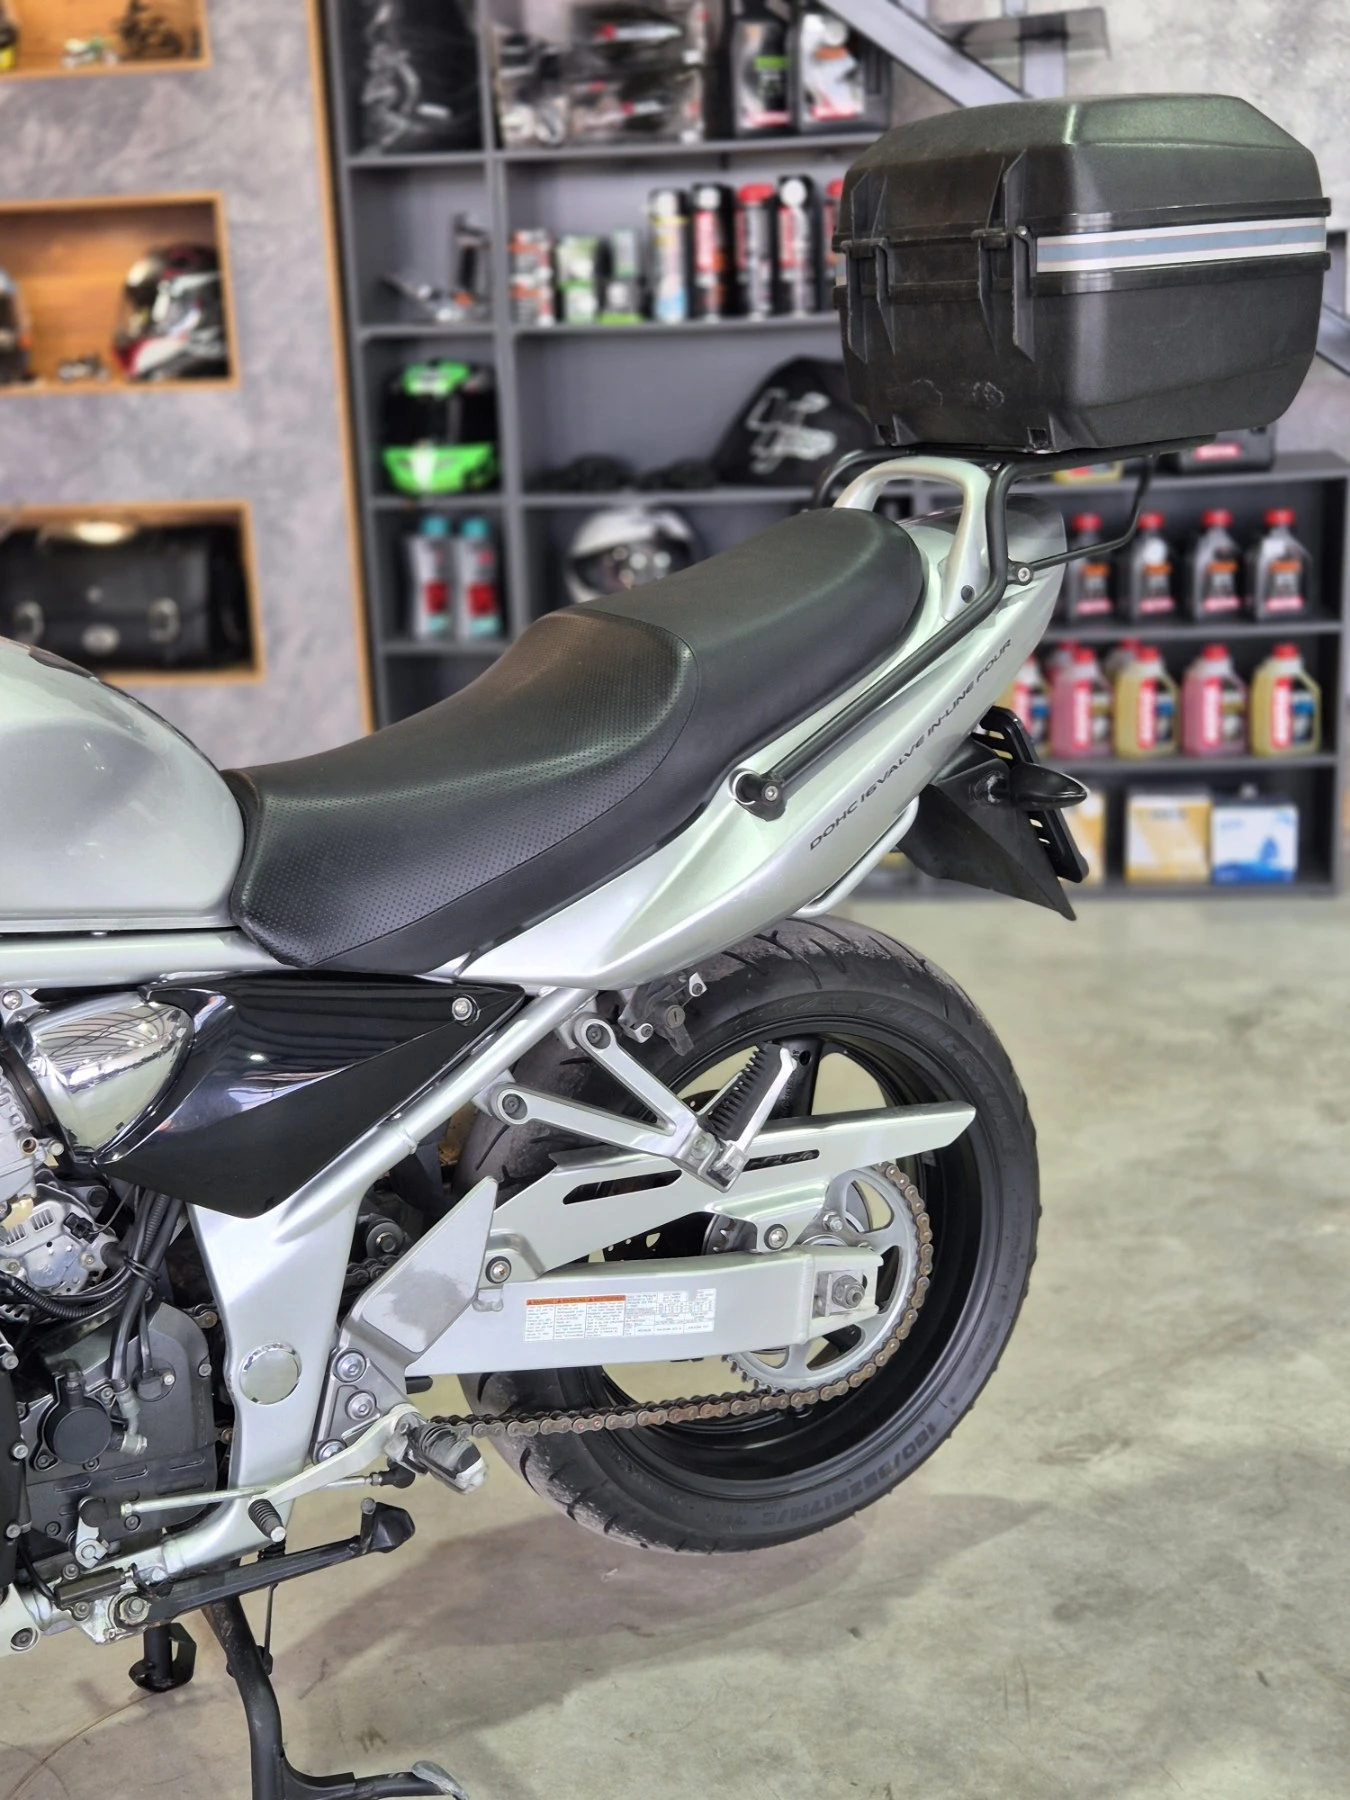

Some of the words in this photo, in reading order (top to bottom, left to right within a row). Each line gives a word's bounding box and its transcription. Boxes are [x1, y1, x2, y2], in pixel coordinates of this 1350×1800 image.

[810, 800, 858, 850] DOHC
[928, 681, 974, 736] IN-LINE
[977, 639, 1011, 682] FOUR
